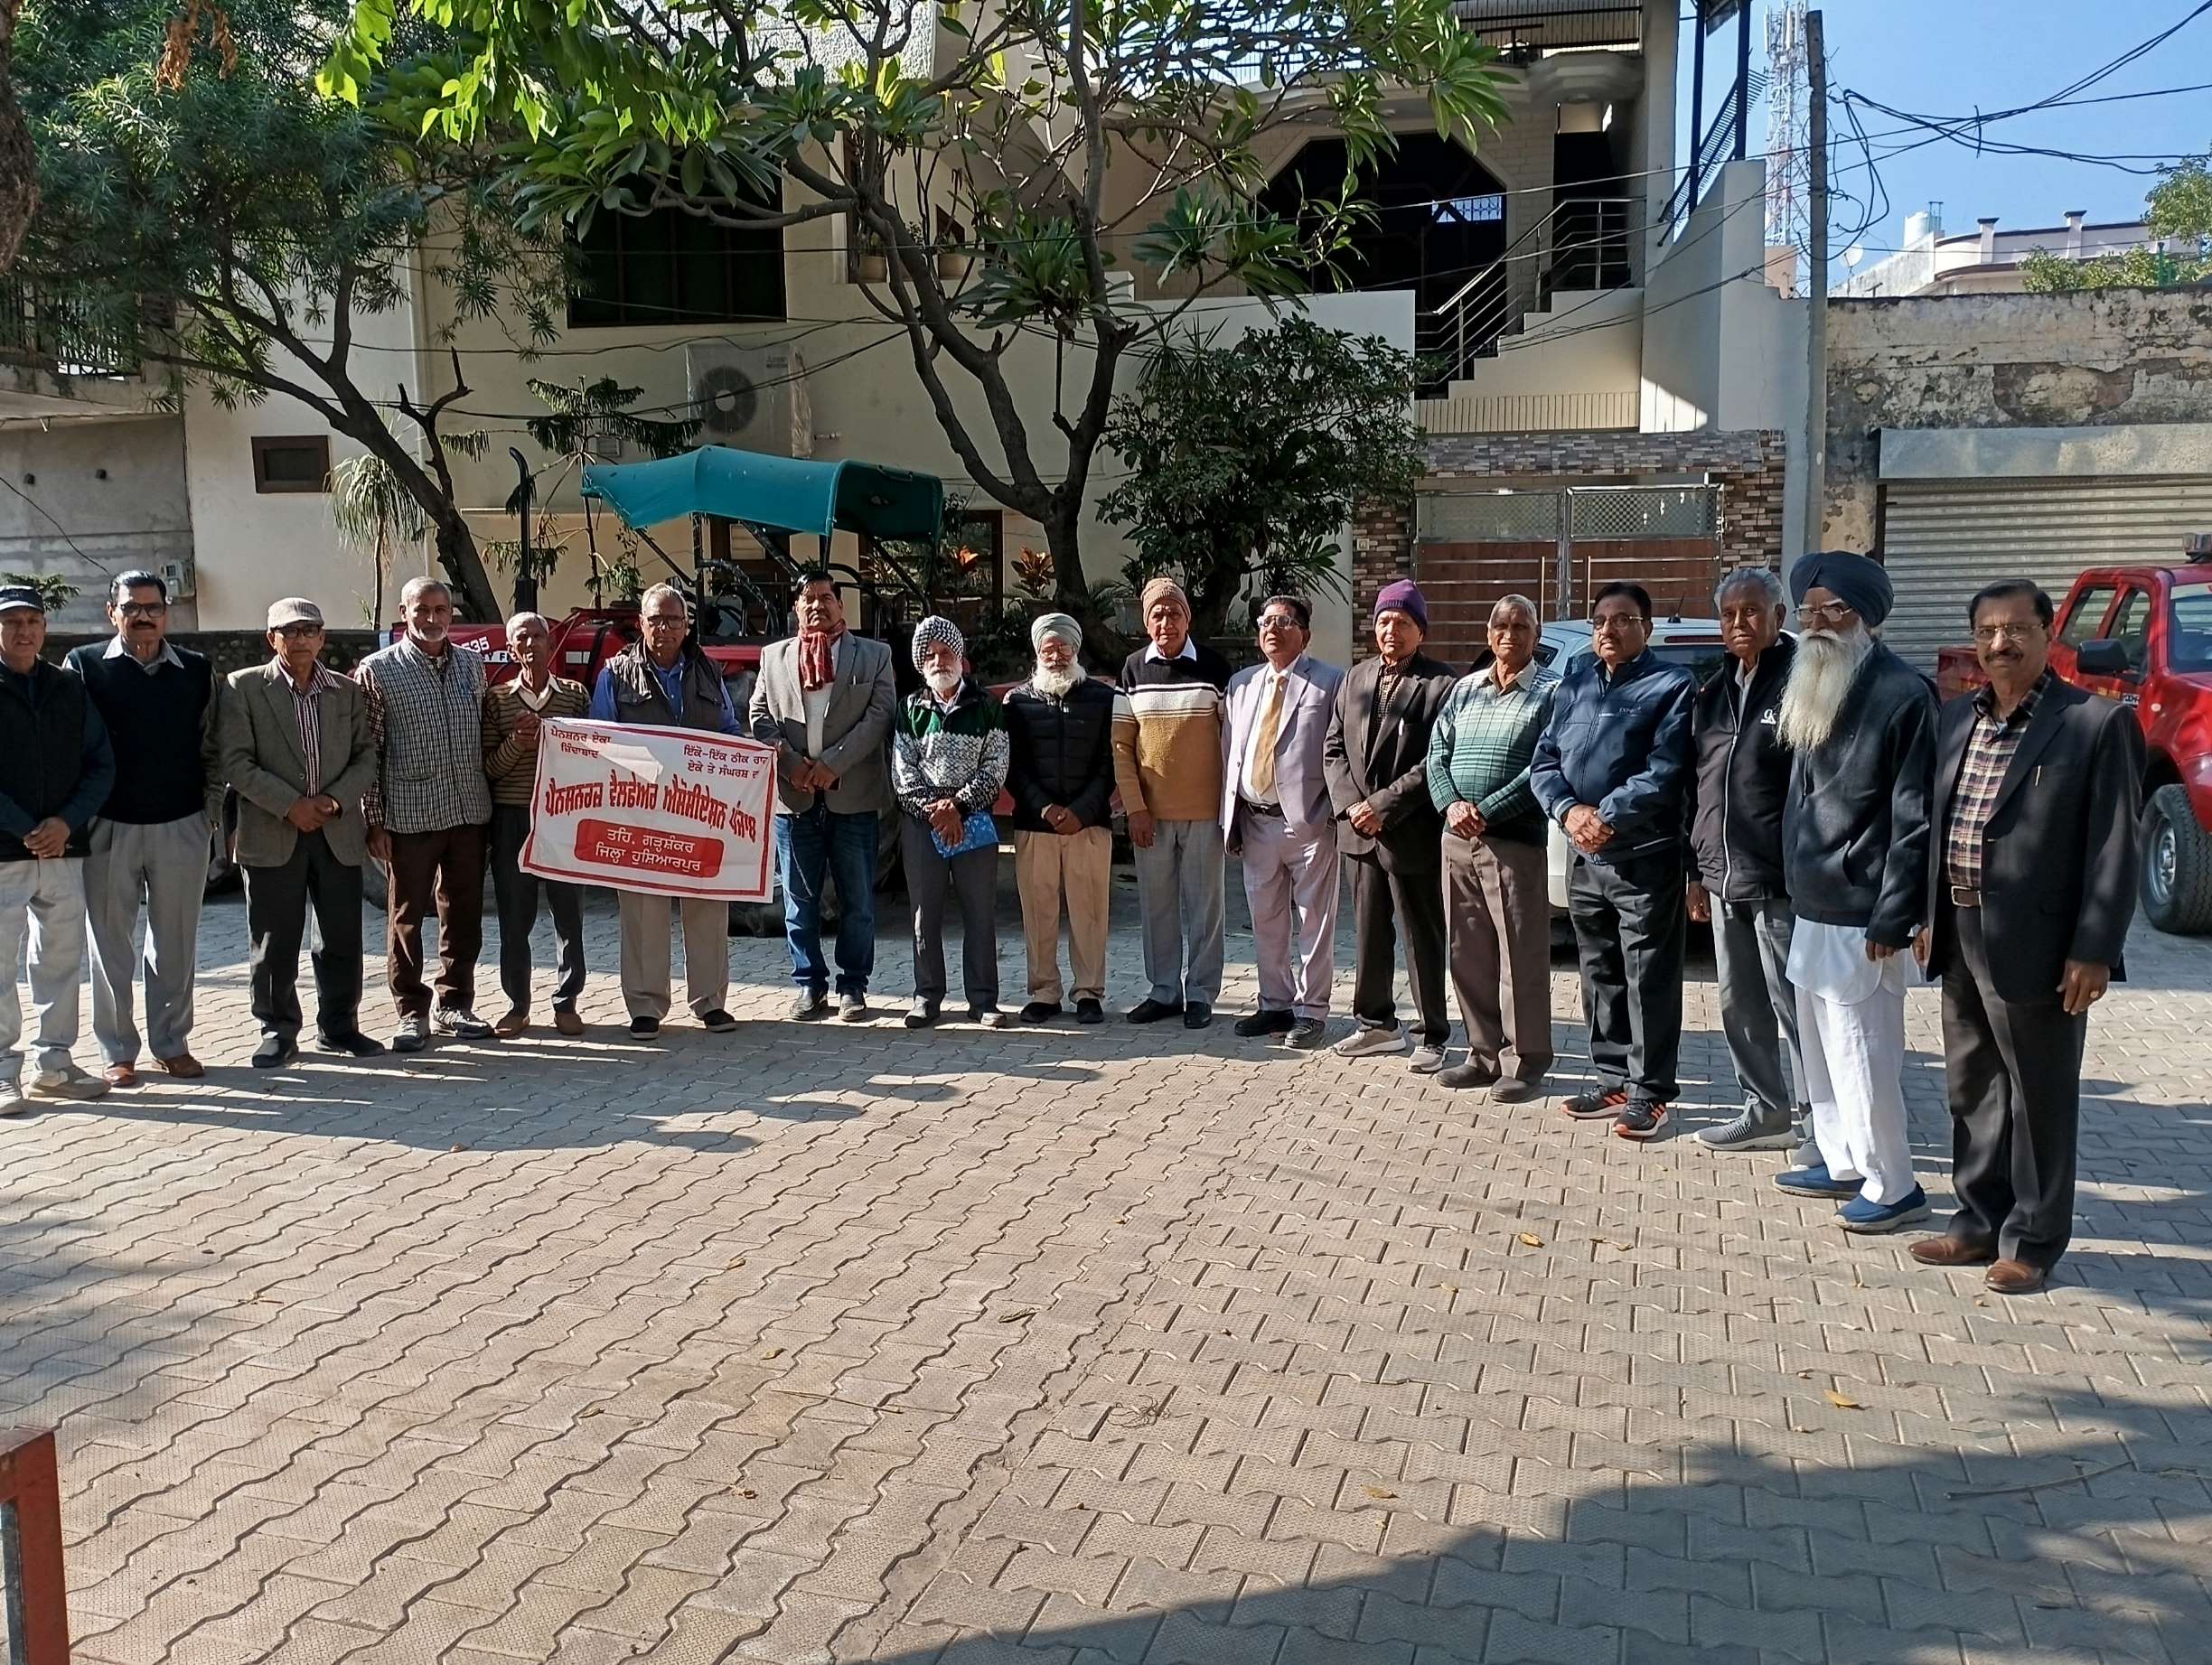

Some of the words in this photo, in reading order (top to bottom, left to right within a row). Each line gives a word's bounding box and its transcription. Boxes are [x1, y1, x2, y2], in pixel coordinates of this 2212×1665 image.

[592, 731, 612, 744] ਏਕਾ
[731, 752, 749, 764] ਠੀਕ
[708, 762, 716, 774] ਤੇ
[729, 800, 756, 844] ਪੰਜਾਬ
[606, 827, 636, 845] ਤਹਿ.
